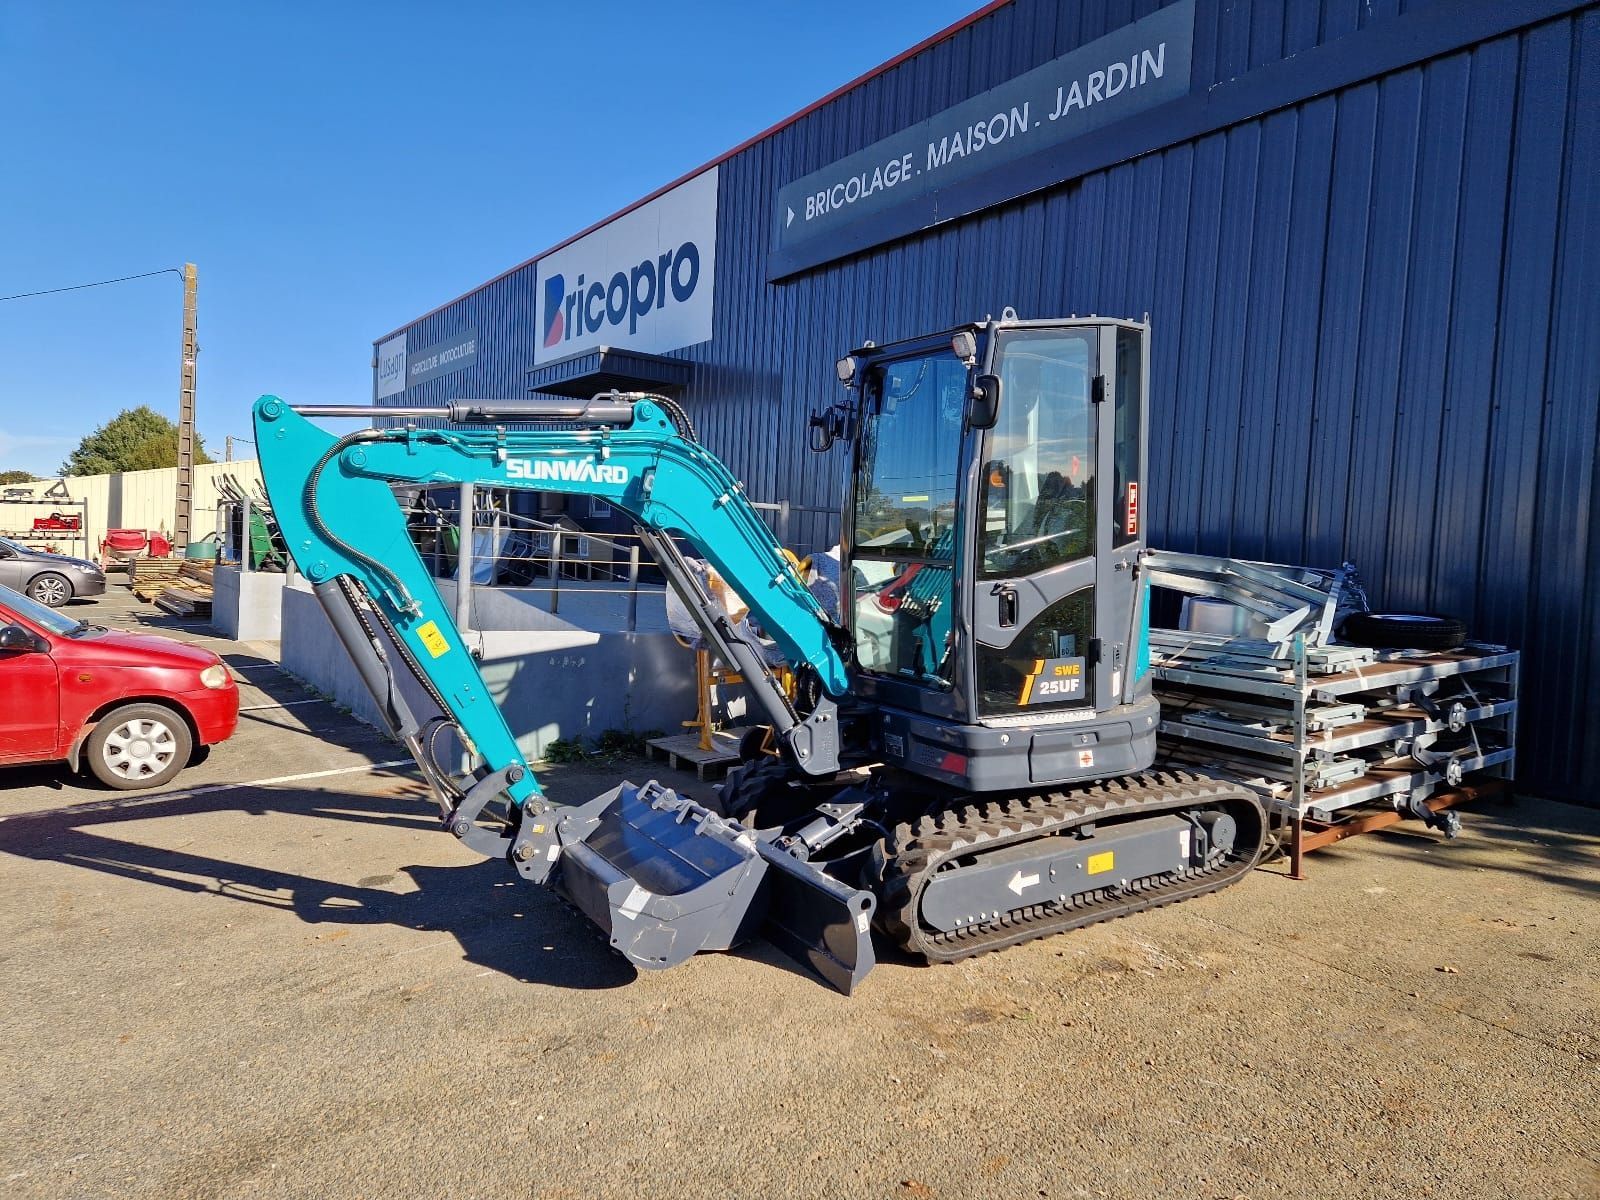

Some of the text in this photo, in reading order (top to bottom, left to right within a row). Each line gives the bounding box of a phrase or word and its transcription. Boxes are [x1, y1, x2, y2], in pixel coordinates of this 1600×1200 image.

[805, 42, 1166, 221] BRICOLAGE MAISON JARDIN
[544, 242, 700, 348] Bricopro
[506, 456, 629, 484] SUNWARD
[1055, 665, 1080, 676] SWE
[1040, 678, 1080, 695] 25UF
